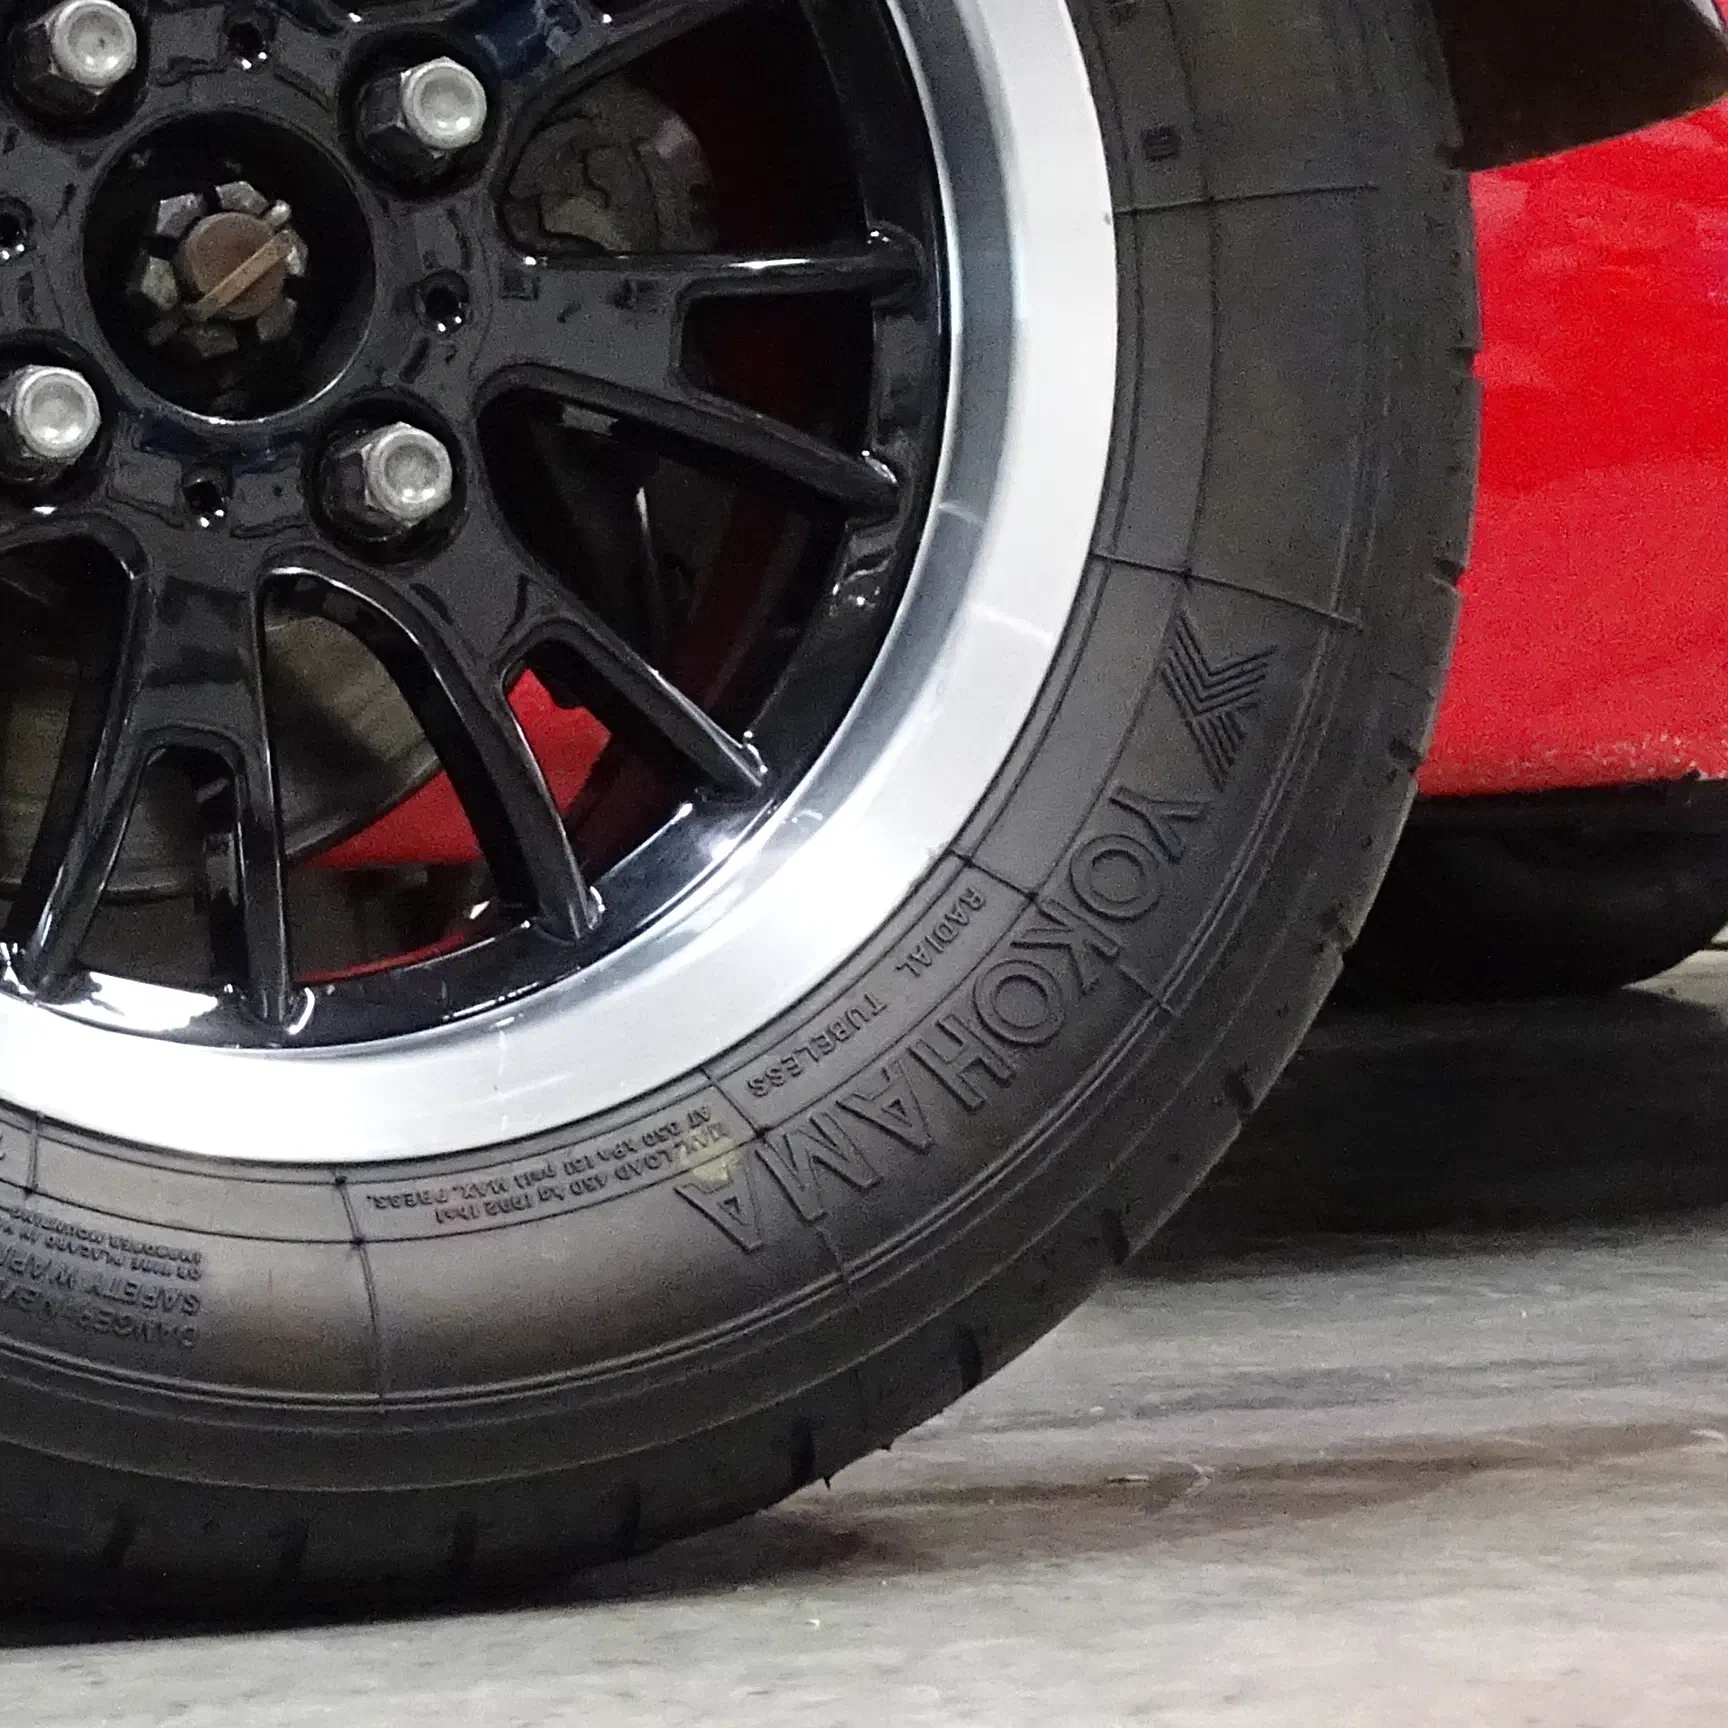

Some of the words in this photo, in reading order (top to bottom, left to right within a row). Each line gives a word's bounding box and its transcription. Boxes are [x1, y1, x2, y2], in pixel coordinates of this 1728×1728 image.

[893, 883, 988, 986] RADIAL
[674, 777, 1211, 1254] YOKOHAMA
[743, 984, 888, 1107] TUBELESS
[612, 1142, 674, 1187] LOAD
[80, 1267, 200, 1317] SAFETY
